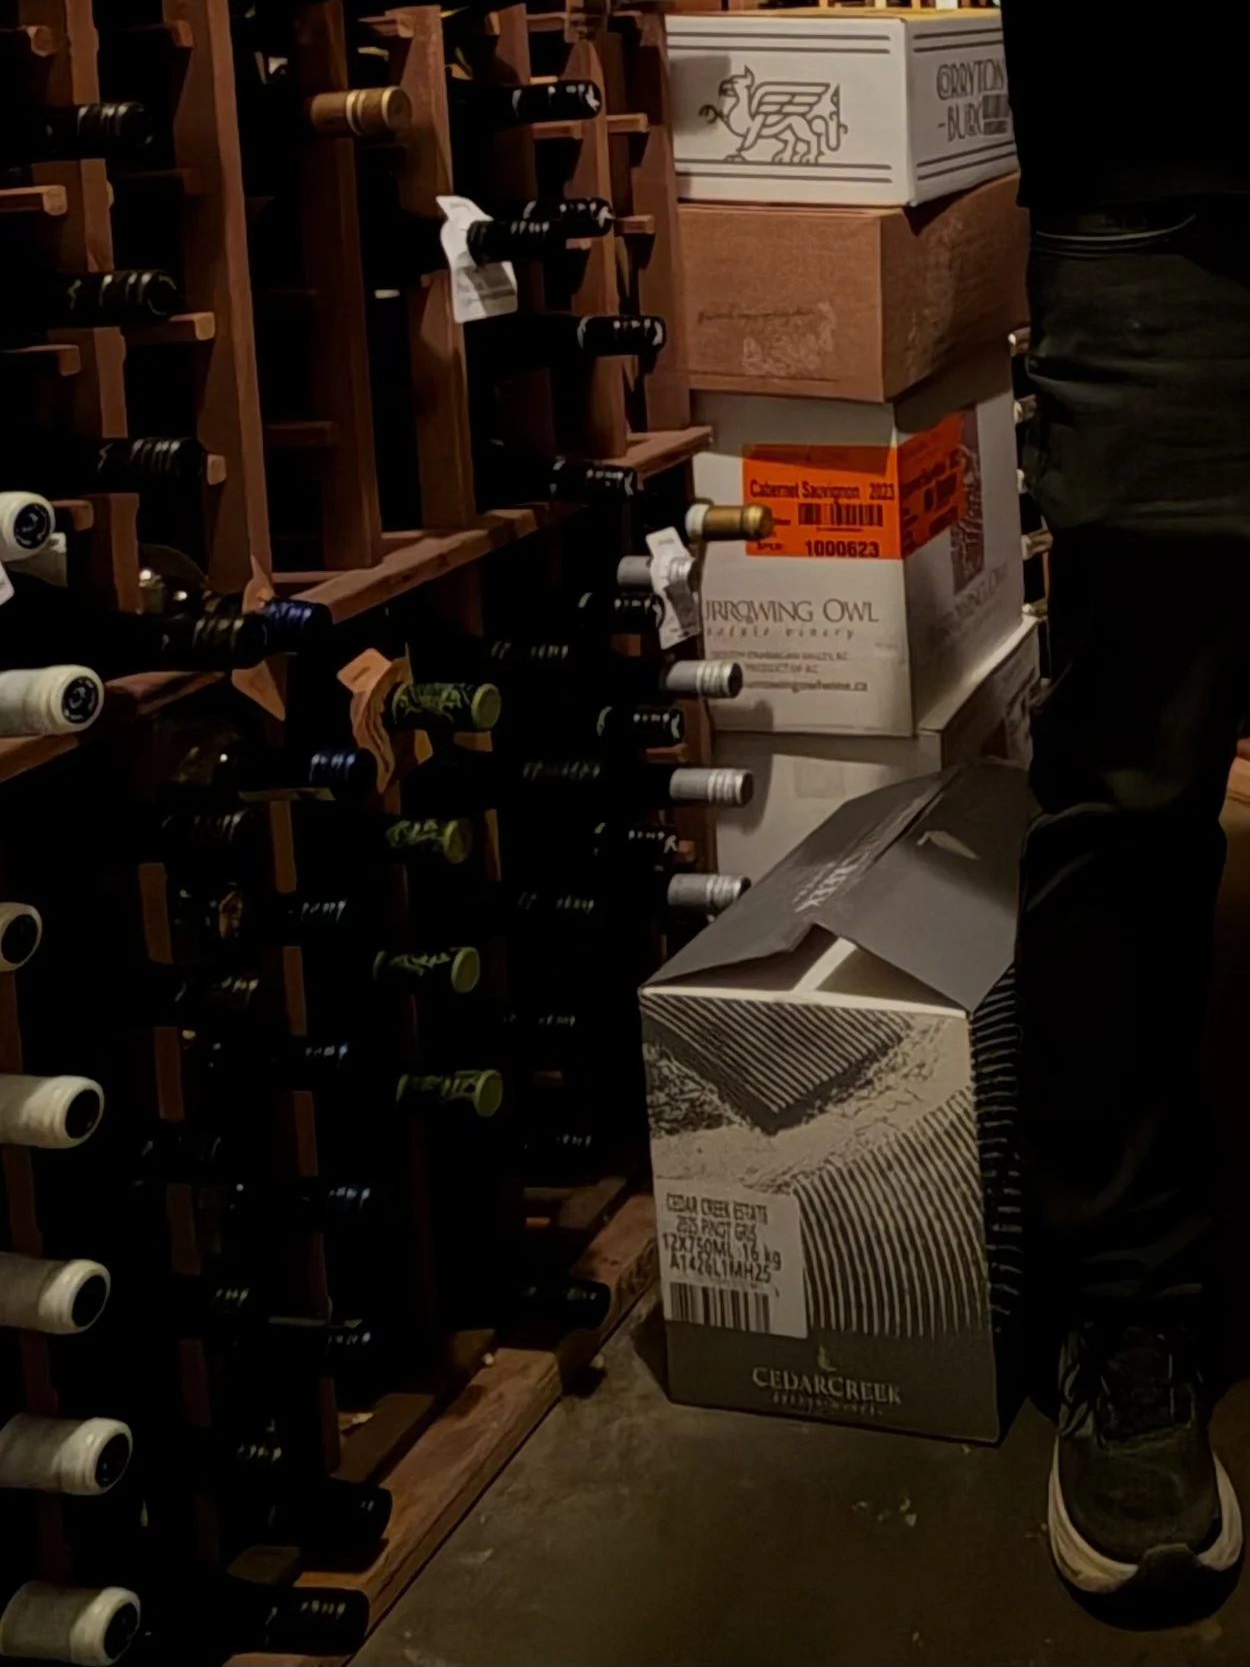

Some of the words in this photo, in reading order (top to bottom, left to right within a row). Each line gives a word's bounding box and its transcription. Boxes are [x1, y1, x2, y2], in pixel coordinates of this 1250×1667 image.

[750, 479, 799, 498] Cabernet
[802, 480, 861, 503] Sauvignon
[805, 539, 880, 558] 1000623
[823, 598, 880, 623] OWL
[667, 1193, 698, 1213] CEDAR
[701, 1197, 732, 1218] CREEK
[763, 1242, 782, 1271] kg
[752, 1366, 902, 1405] CEDARCREEK
